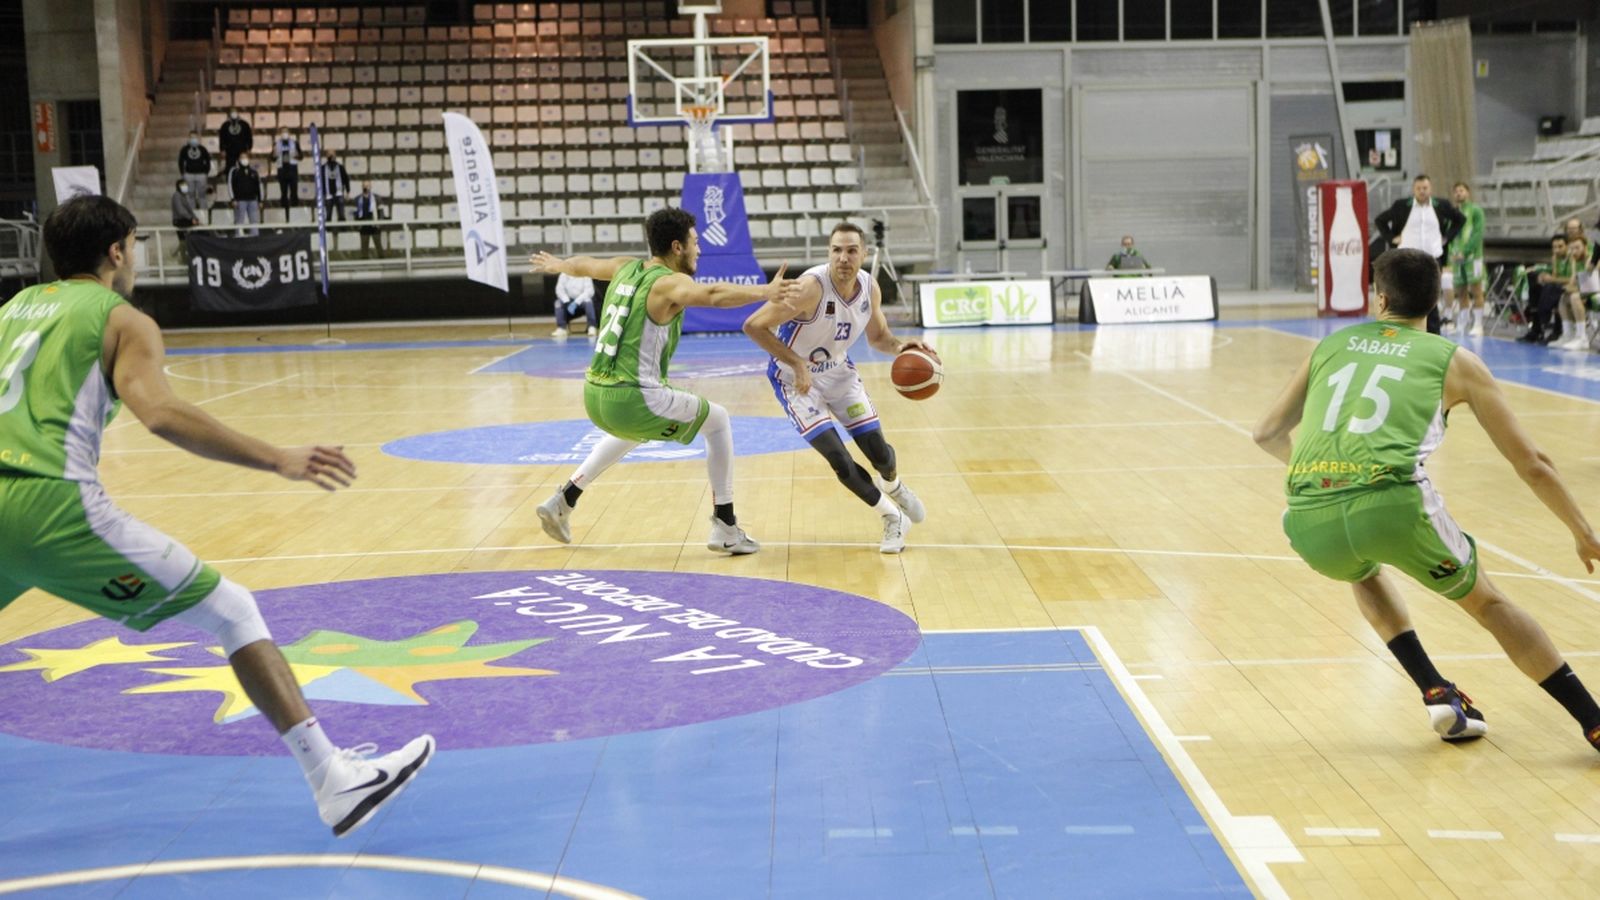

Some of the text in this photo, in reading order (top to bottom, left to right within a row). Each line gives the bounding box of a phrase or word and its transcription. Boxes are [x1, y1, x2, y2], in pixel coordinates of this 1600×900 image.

[192, 256, 222, 287] 19
[278, 250, 310, 284] 96
[940, 297, 986, 315] CRC
[1124, 304, 1180, 316] ALICANTE
[595, 304, 630, 356] 25
[834, 322, 852, 341] 23
[1347, 336, 1412, 358] SABATÉ
[1322, 362, 1405, 434] 15
[472, 586, 766, 675] LA NUCÍA
[535, 572, 864, 669] CIUDAD DEL DEPORTE
